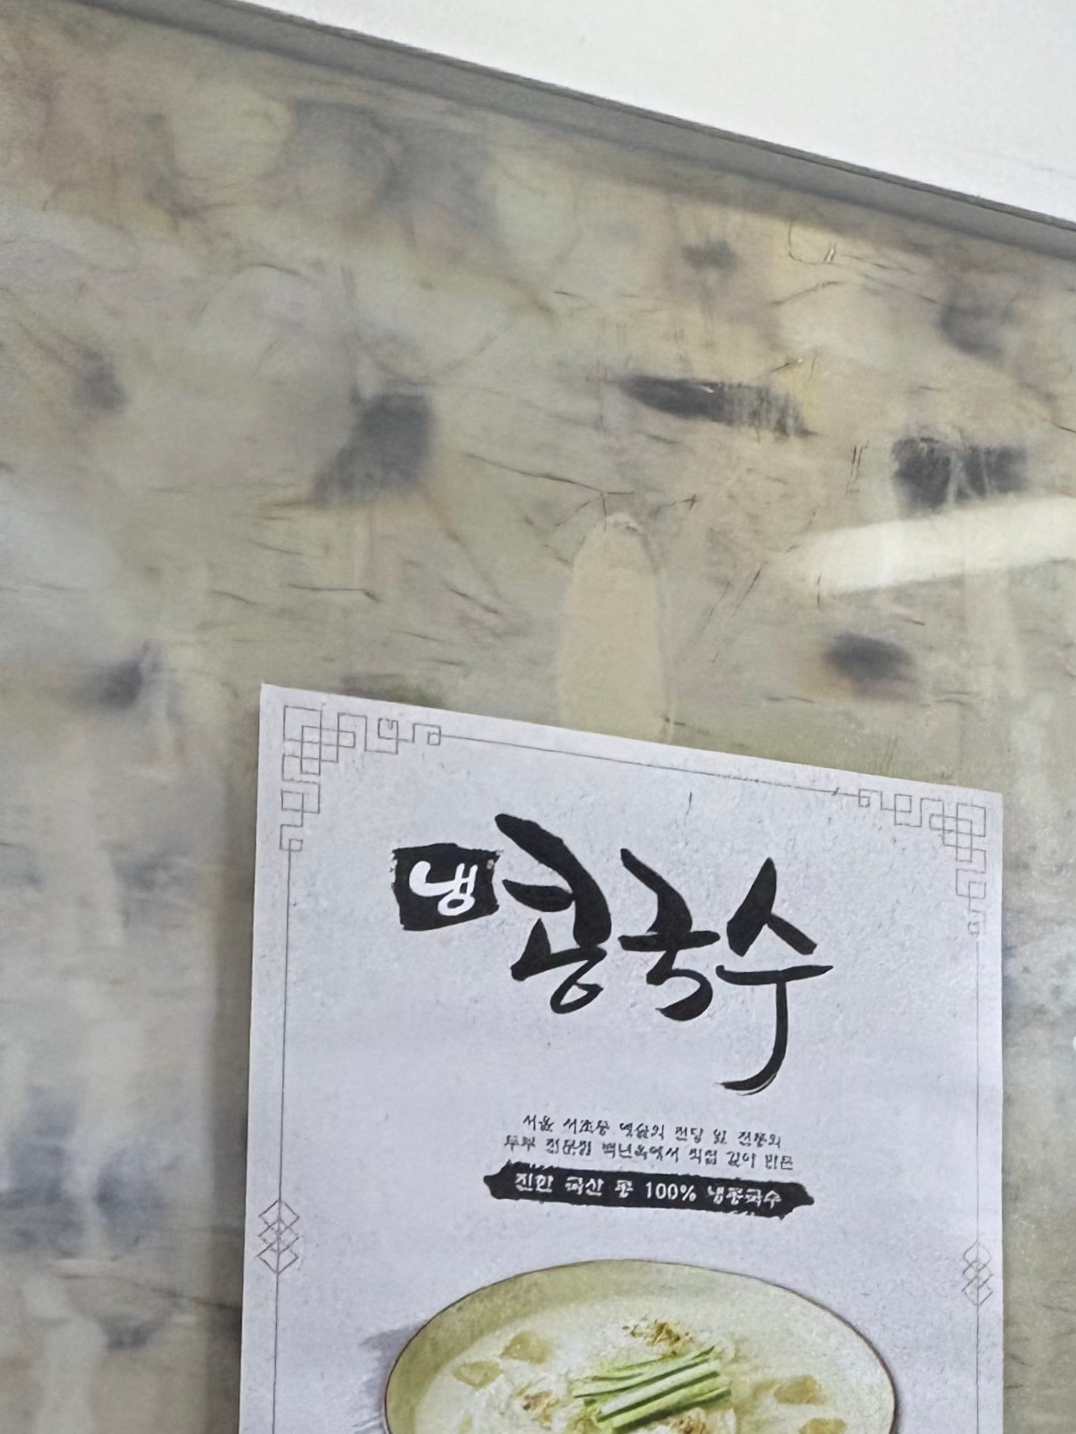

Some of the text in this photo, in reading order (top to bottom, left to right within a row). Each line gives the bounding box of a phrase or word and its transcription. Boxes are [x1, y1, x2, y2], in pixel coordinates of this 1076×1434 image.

[523, 1115, 554, 1132] 서울
[563, 1118, 609, 1136] 서초동
[675, 1126, 704, 1144] 전당
[504, 1134, 536, 1152] 두부
[688, 1148, 717, 1166] 직접
[765, 1154, 794, 1171] 만든
[514, 1171, 783, 1209] 진한 국산 콩 100% 냉콩국수
